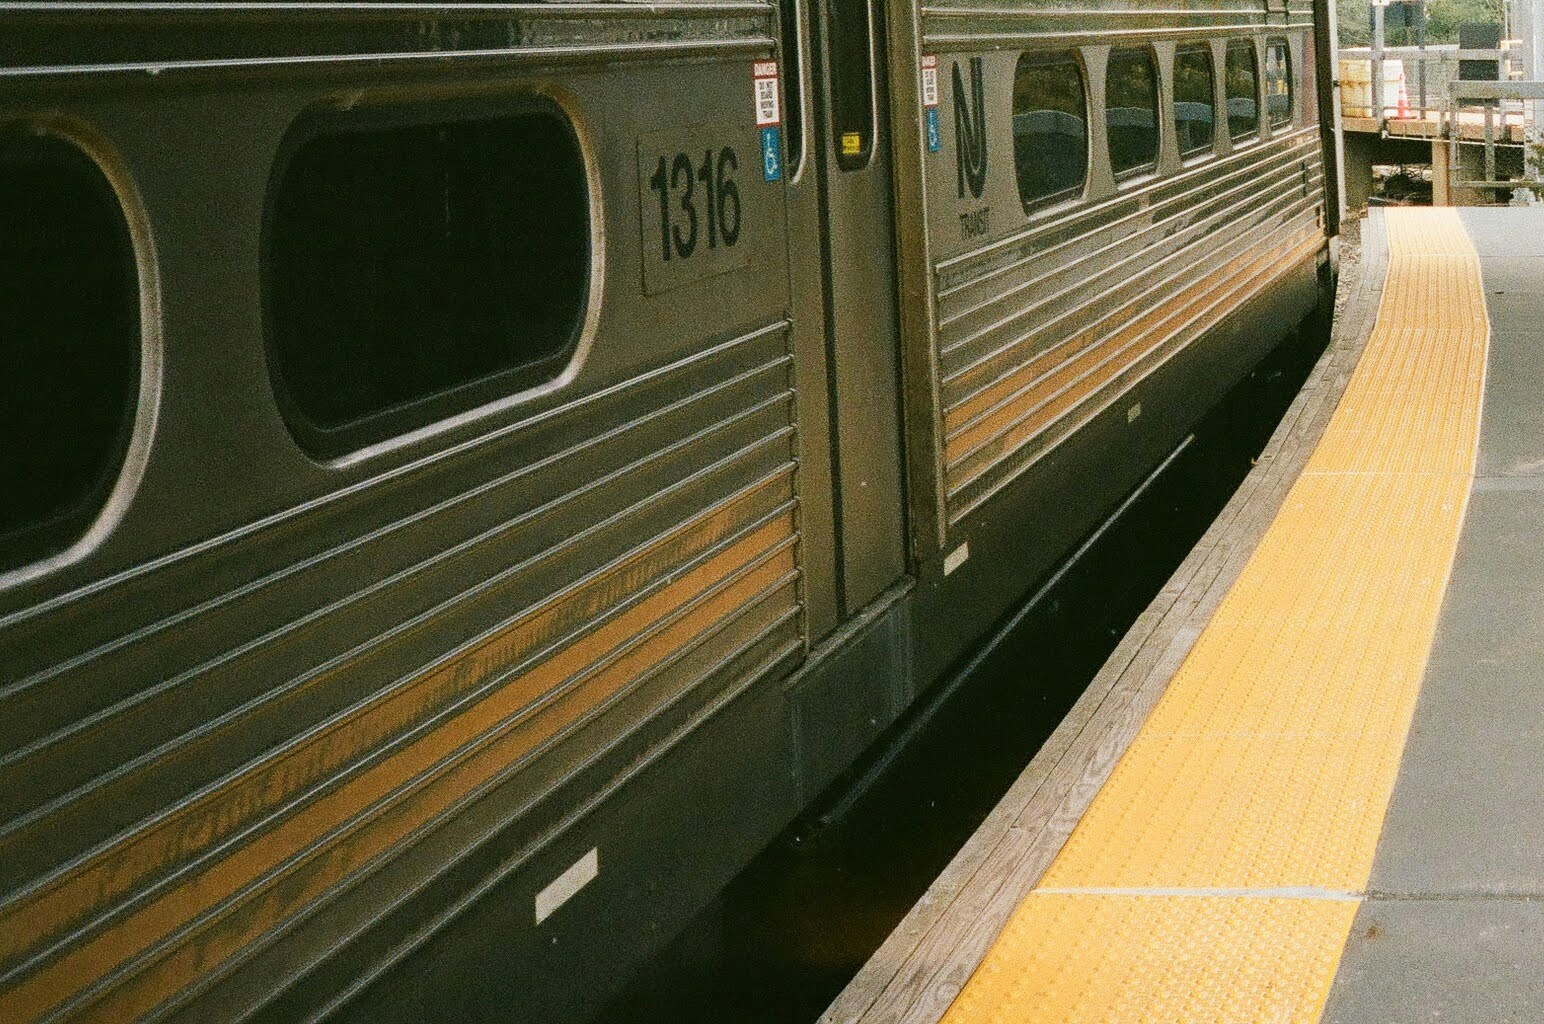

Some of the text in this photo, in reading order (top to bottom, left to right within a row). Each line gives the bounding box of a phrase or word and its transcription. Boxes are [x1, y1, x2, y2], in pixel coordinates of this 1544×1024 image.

[754, 62, 778, 75] DANGER
[650, 145, 742, 262] 1316
[958, 206, 991, 240] TRANSIT
